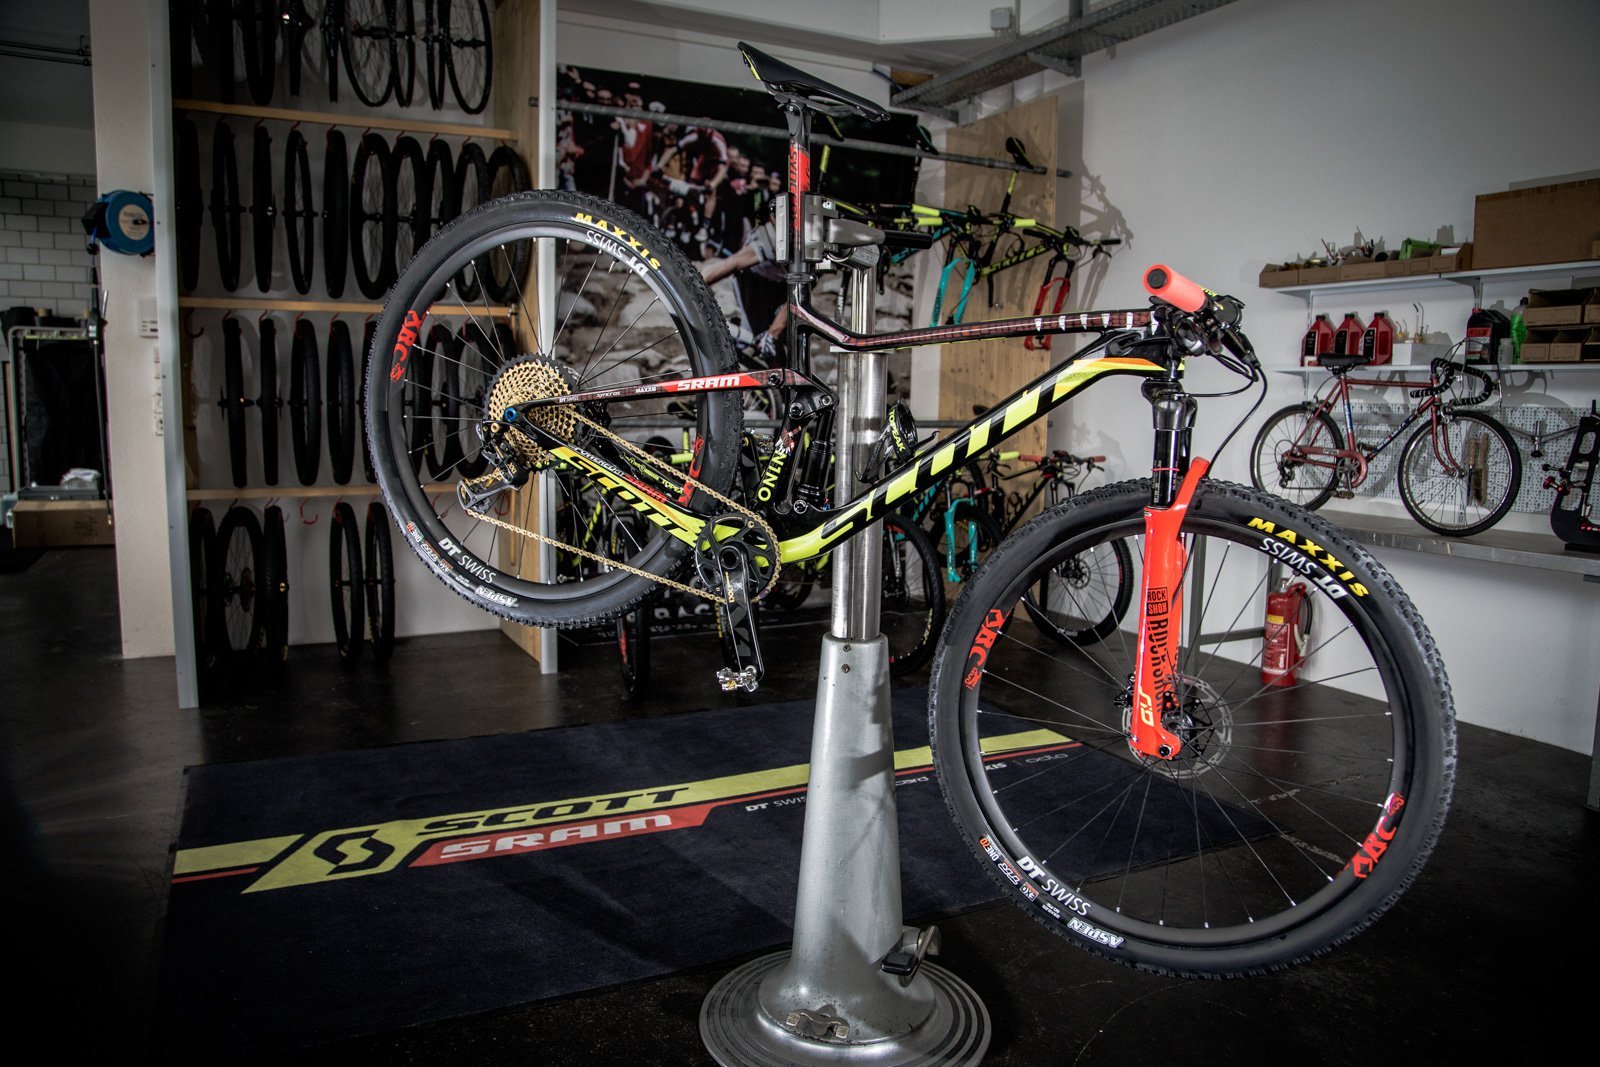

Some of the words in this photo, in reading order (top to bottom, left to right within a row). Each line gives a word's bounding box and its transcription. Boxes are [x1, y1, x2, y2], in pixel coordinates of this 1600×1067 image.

[573, 212, 661, 270] MAXXIS
[586, 230, 625, 258] SWISS
[626, 256, 649, 276] DT
[635, 386, 657, 394] MAXXIS
[677, 375, 741, 391] SRAM
[889, 409, 906, 452] TOPEAK
[568, 455, 690, 532] SCOTT
[438, 537, 462, 557] DT
[458, 555, 497, 584] SWISS
[1247, 517, 1370, 597] MAXXIS
[1260, 538, 1318, 574] SWISS
[1147, 589, 1167, 600] ROCK
[1313, 575, 1348, 599] DT
[416, 787, 689, 836] SCOTT
[745, 802, 769, 812] DT
[440, 814, 672, 859] SRAM
[979, 837, 1000, 862] ONE70
[1016, 855, 1046, 879] DT
[1041, 879, 1091, 916] SWISS
[1067, 916, 1124, 949] ASPEN
